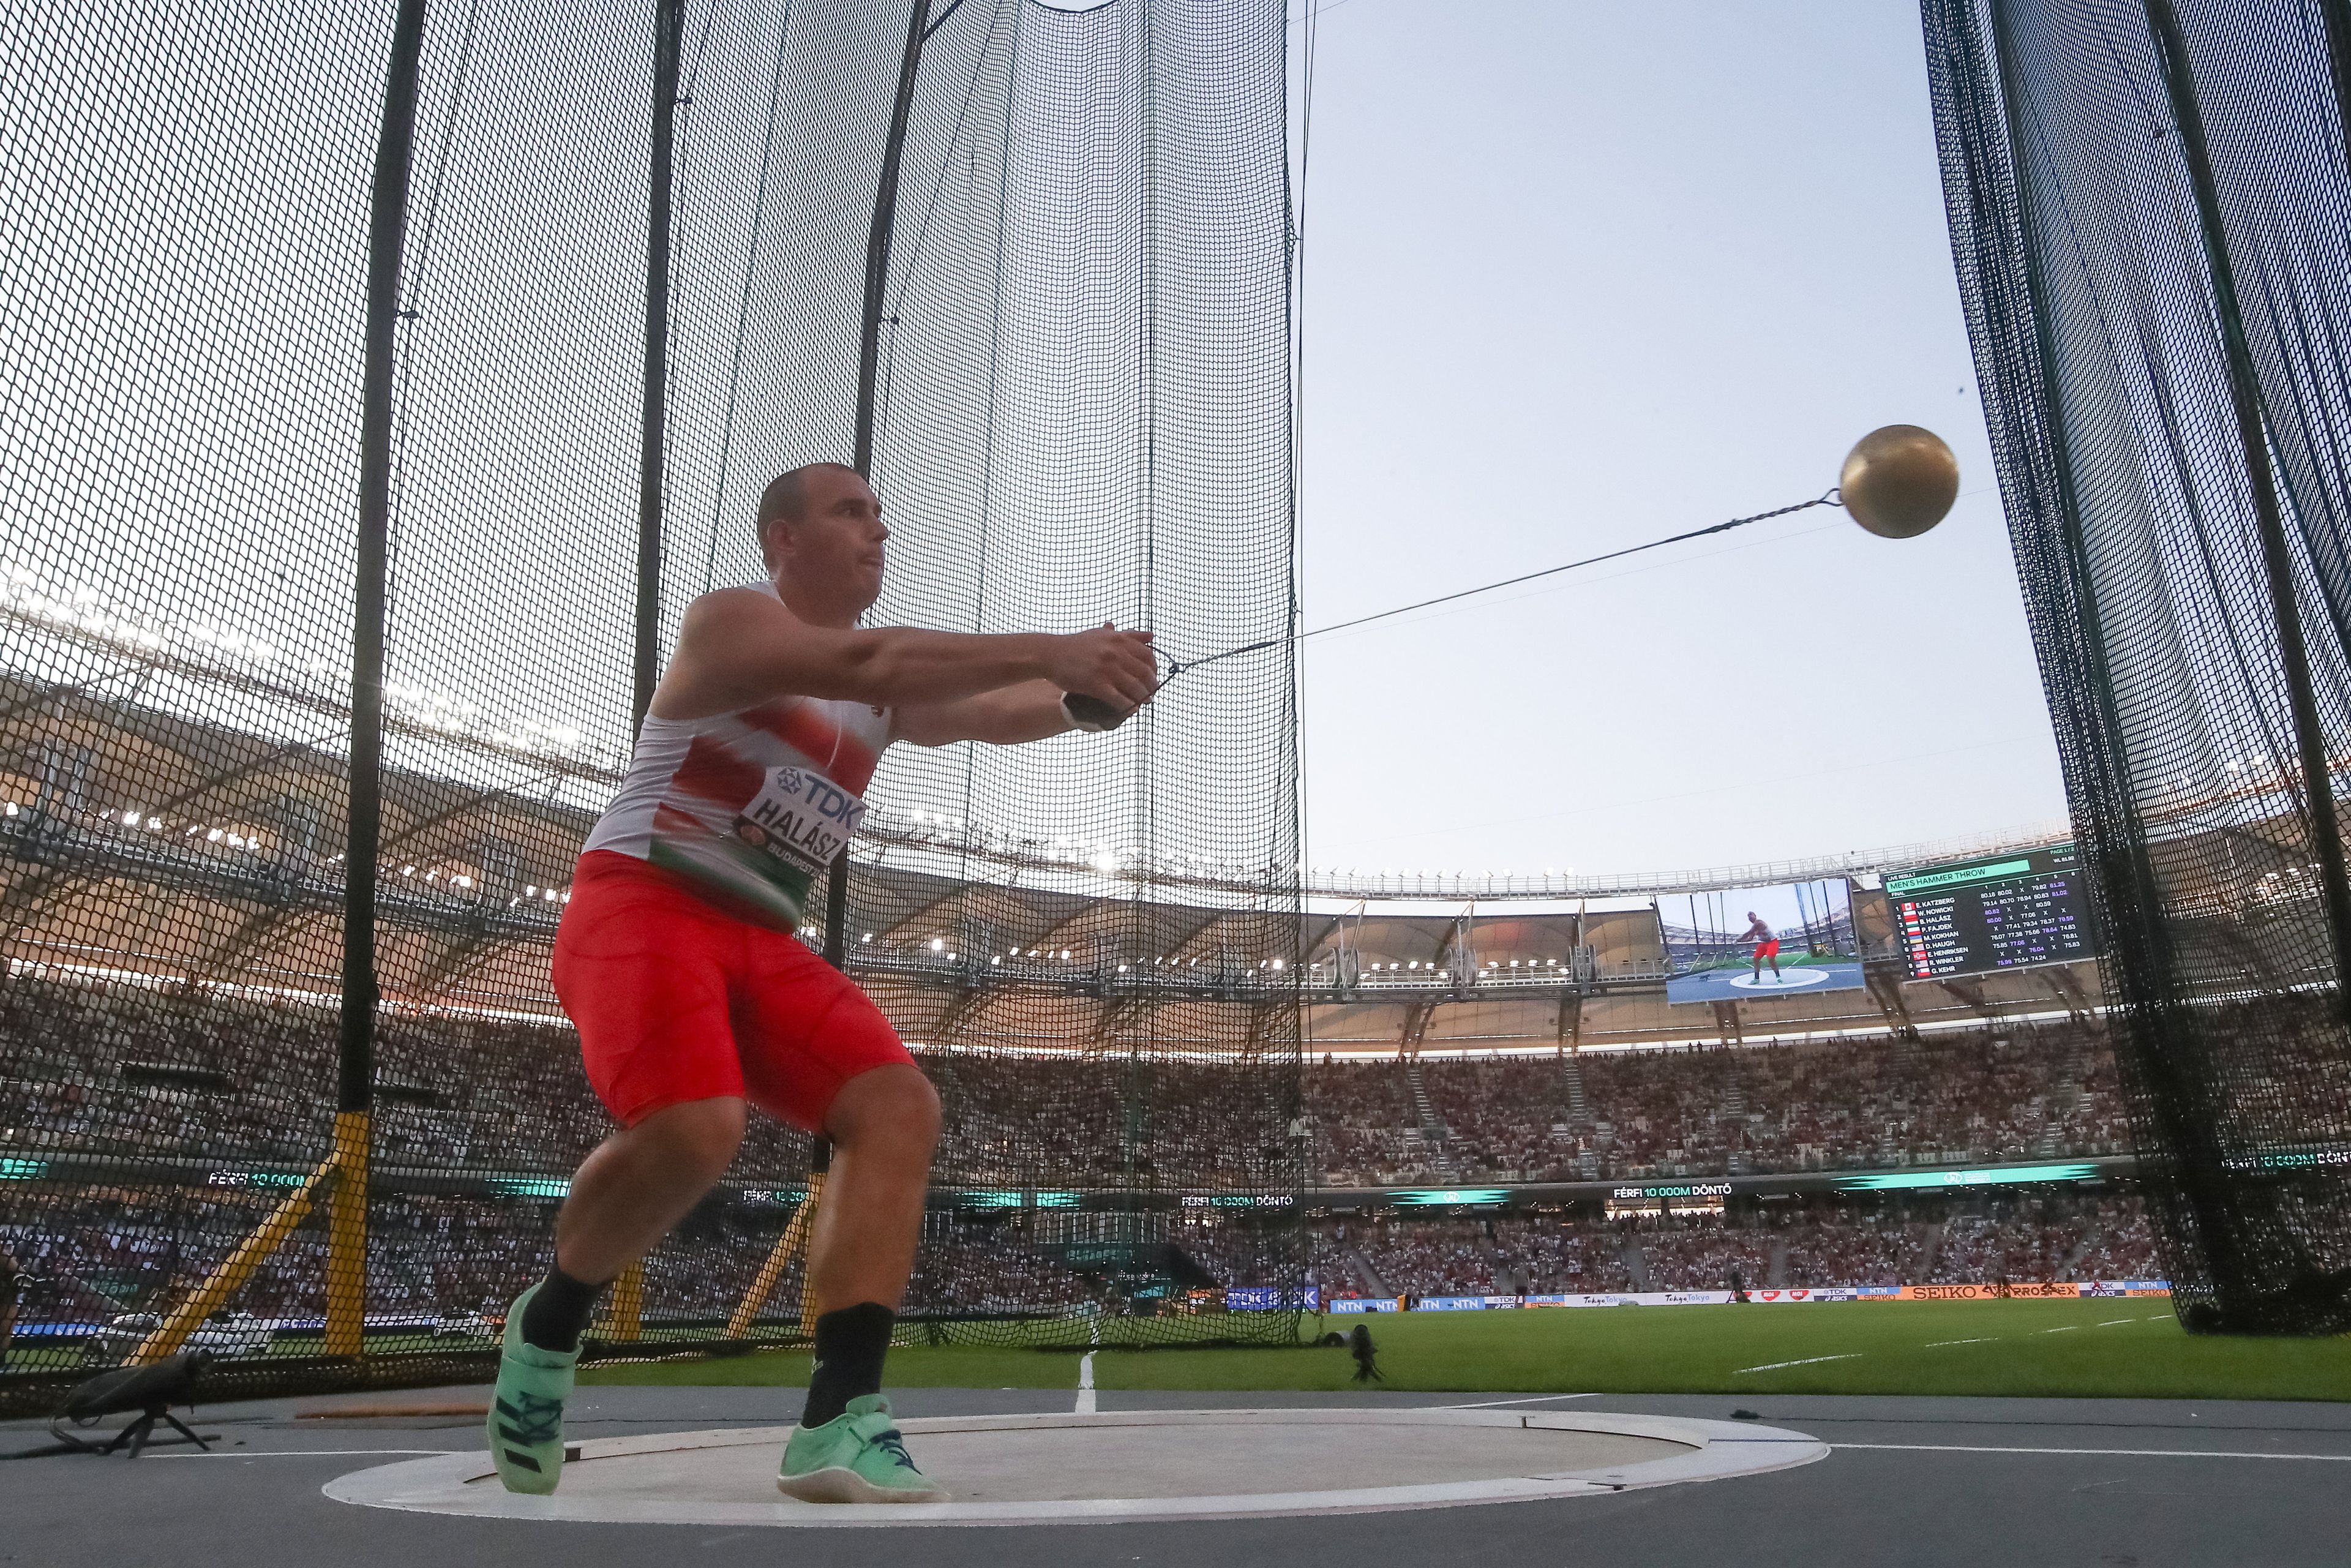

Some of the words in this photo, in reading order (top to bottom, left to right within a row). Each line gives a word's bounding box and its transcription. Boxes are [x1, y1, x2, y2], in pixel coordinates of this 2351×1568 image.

[804, 774, 864, 830] TDK
[752, 798, 841, 860] HALÁSZ
[767, 842, 816, 874] BUDAPEST
[1890, 880, 1915, 889] MEN'S
[1916, 874, 1953, 885] HAMMER
[1955, 868, 1986, 879] THROW
[1922, 898, 1955, 907] KATZBERG
[1926, 906, 1954, 915] NOWICKI
[1926, 915, 1952, 924] HALÁSZ
[1928, 923, 1953, 932] FAJDEK
[1932, 931, 1959, 940] KOKHAN
[1933, 947, 1969, 957] HENRIKSEN
[1935, 956, 1964, 965] WINKLER
[251, 1173, 268, 1186] 10
[1614, 1187, 1643, 1199] FÉRFI
[1644, 1188, 1657, 1197] 10
[1659, 1187, 1690, 1197] 000M
[1692, 1182, 1732, 1195] DÖNTŐ
[1182, 1195, 1209, 1206] FÉRFI
[1211, 1197, 1222, 1206] 10
[1224, 1197, 1254, 1206] 000M
[1913, 1286, 1976, 1299] SEIKO
[1584, 1296, 1606, 1307] Tokyo
[1665, 1294, 1687, 1305] Tokyo
[1687, 1294, 1710, 1302] Tokyo
[1337, 1302, 1363, 1312] NTN
[1453, 1299, 1479, 1309] NTN
